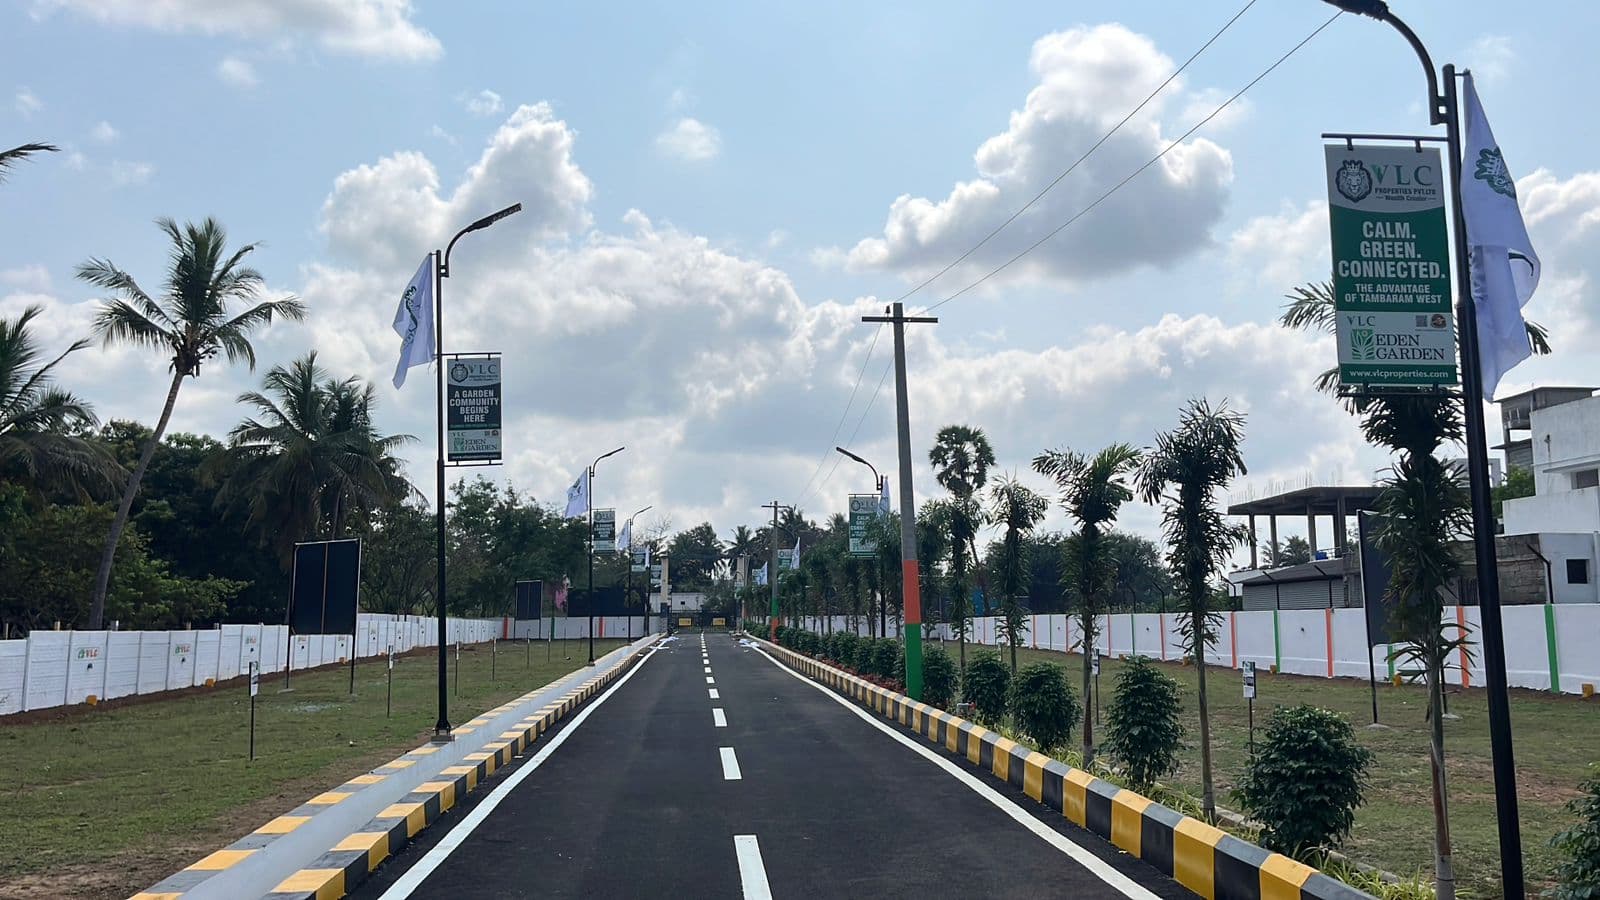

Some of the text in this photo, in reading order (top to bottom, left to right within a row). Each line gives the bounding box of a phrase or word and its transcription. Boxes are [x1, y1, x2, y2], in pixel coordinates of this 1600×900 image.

[1370, 164, 1432, 186] VLC
[1374, 187, 1412, 195] PROPERTIES
[1362, 221, 1417, 239] CALM.
[1360, 240, 1422, 259] GREEN.
[1338, 260, 1446, 279] CONNECTED.
[1356, 283, 1431, 294] THE ADVANTAGE
[1344, 293, 1443, 304] OF TAMBARAM WEST
[1346, 315, 1376, 327] VLC
[1375, 333, 1421, 347] EDEN
[1375, 347, 1445, 360] GARDEN
[468, 364, 497, 374] VLC
[1349, 369, 1449, 379] www.vlcproperties.com
[454, 389, 494, 399] A GARDEN
[449, 398, 499, 407] COMMUNITY
[460, 406, 489, 415] BEGINS
[463, 414, 486, 423] HERE
